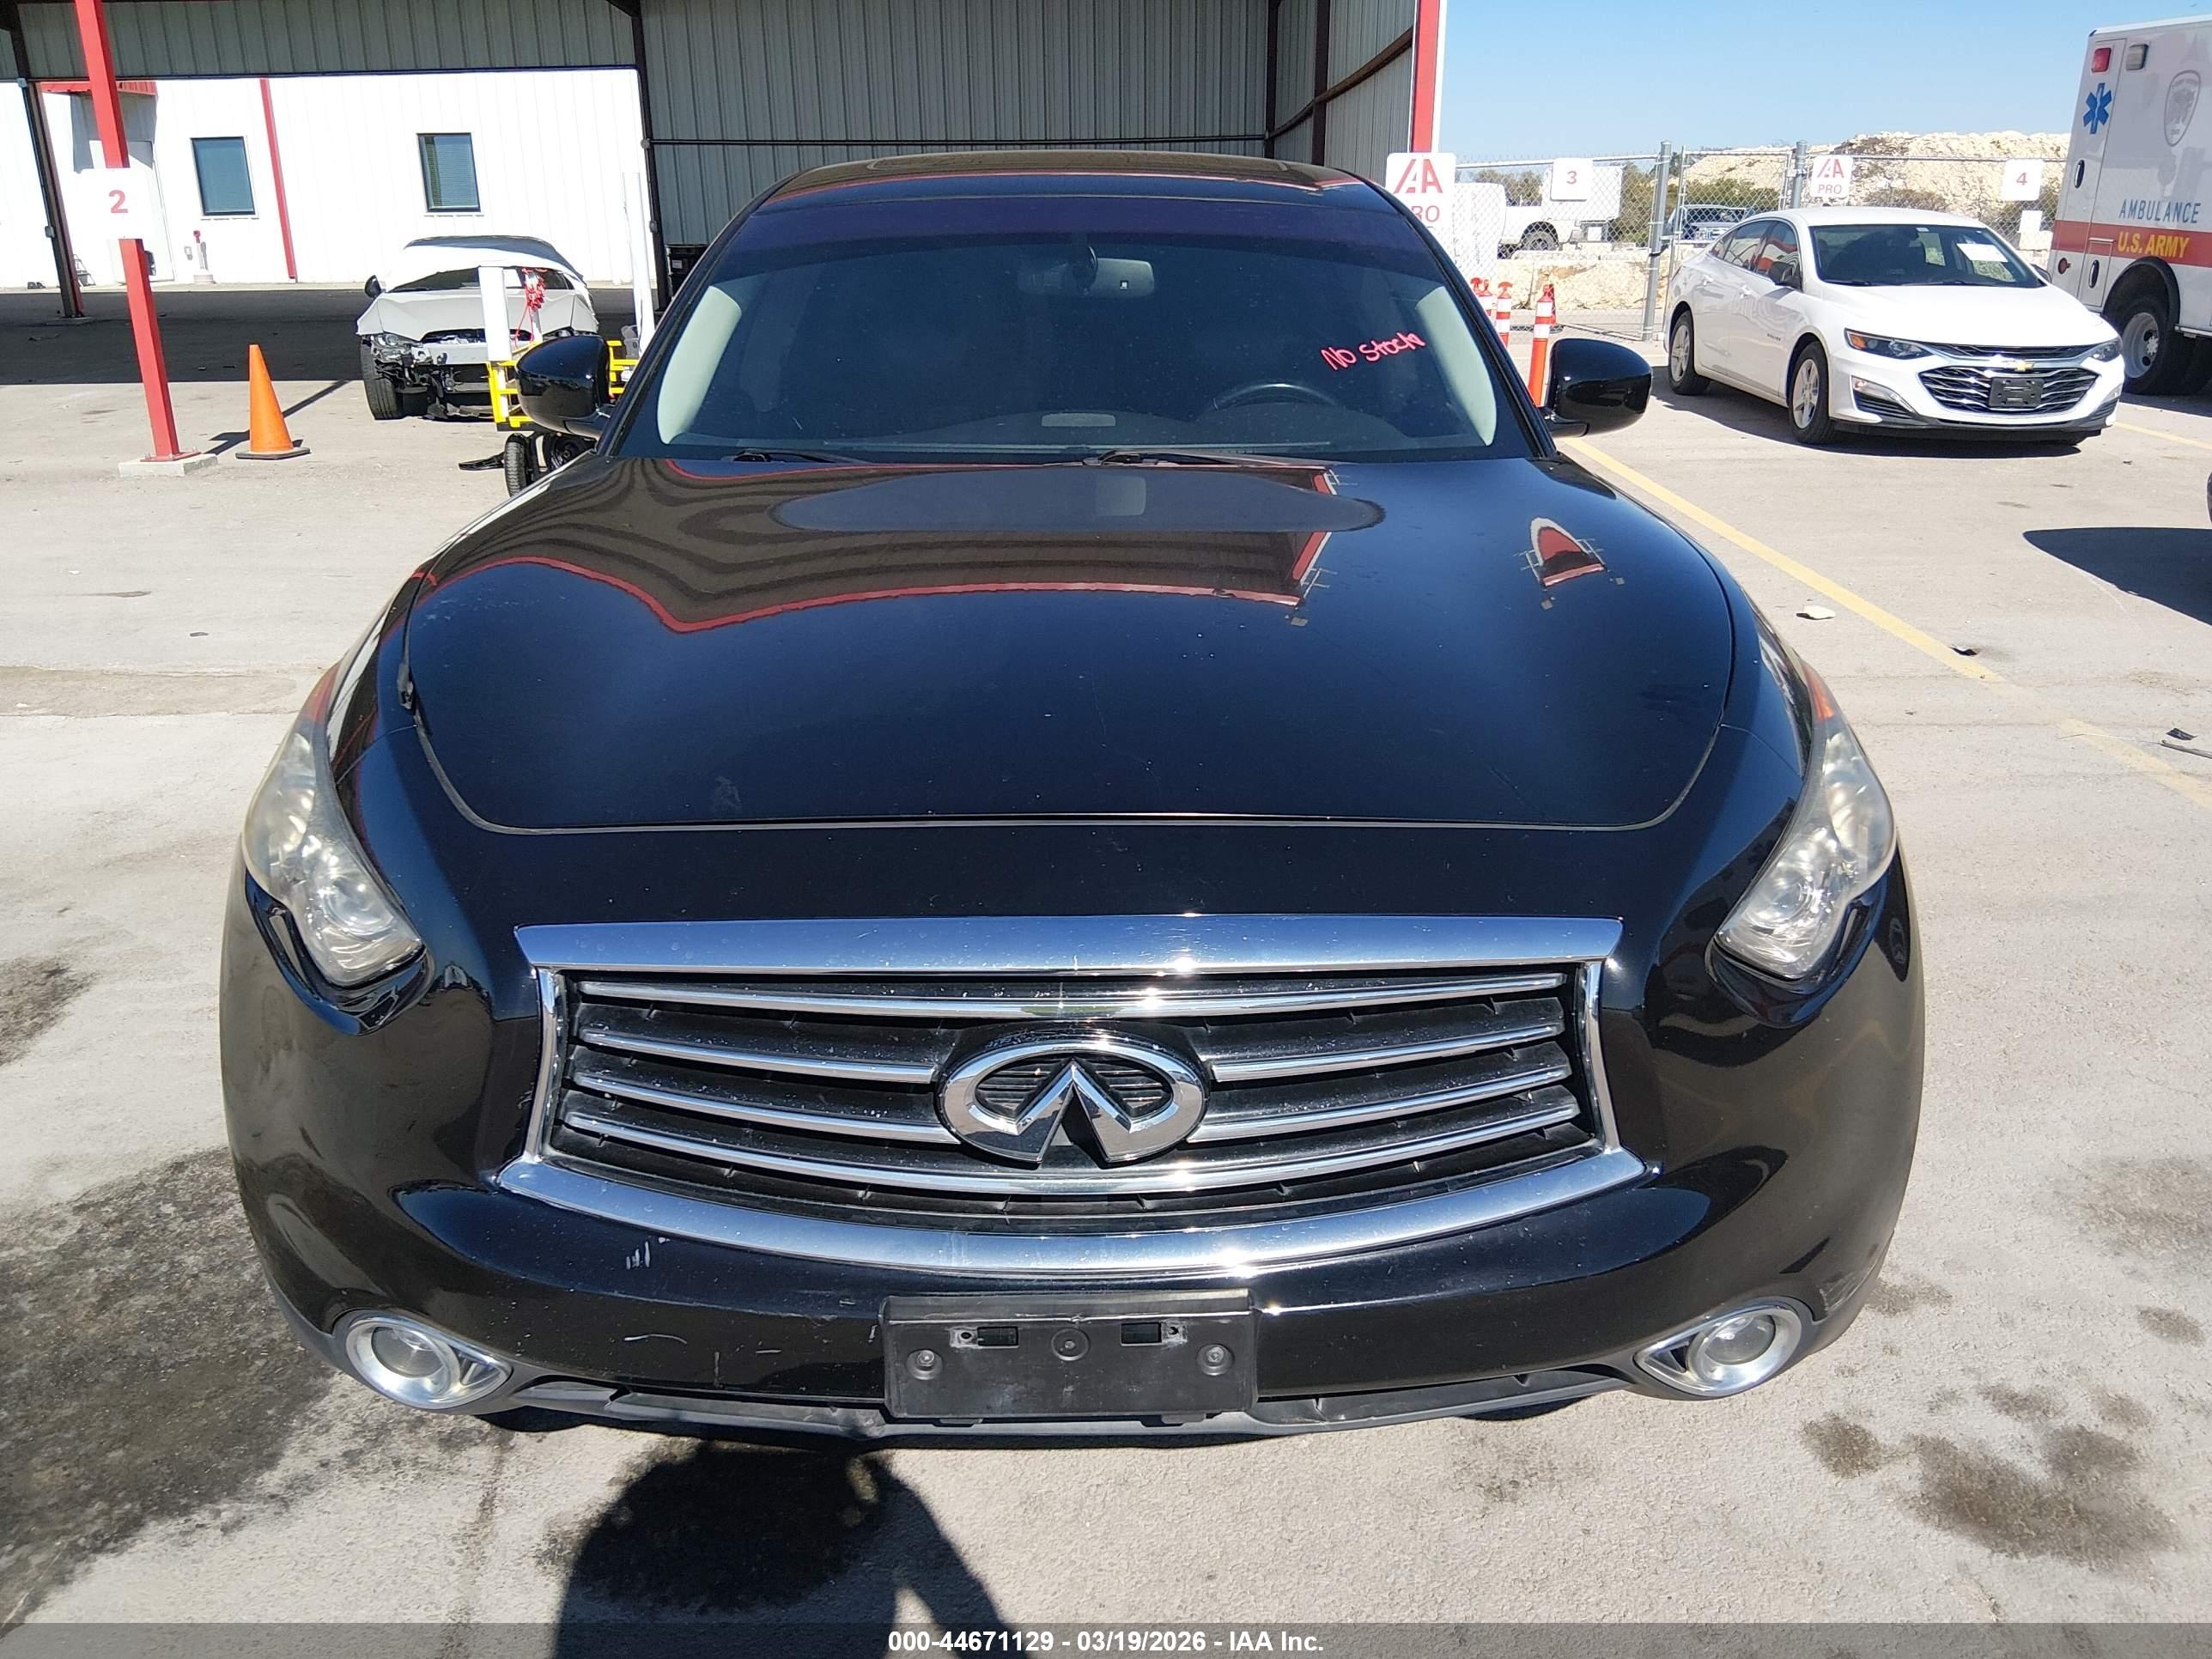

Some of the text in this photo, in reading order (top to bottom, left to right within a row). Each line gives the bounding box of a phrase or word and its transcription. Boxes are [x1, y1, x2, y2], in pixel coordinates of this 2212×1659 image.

[1565, 170, 1577, 185] 3
[2015, 172, 2027, 185] 4
[1817, 184, 1843, 195] PRO
[108, 189, 129, 214] 2
[1411, 204, 1440, 222] RO
[2118, 198, 2202, 224] AMBULANCE
[2117, 231, 2190, 258] U.S. ARMY
